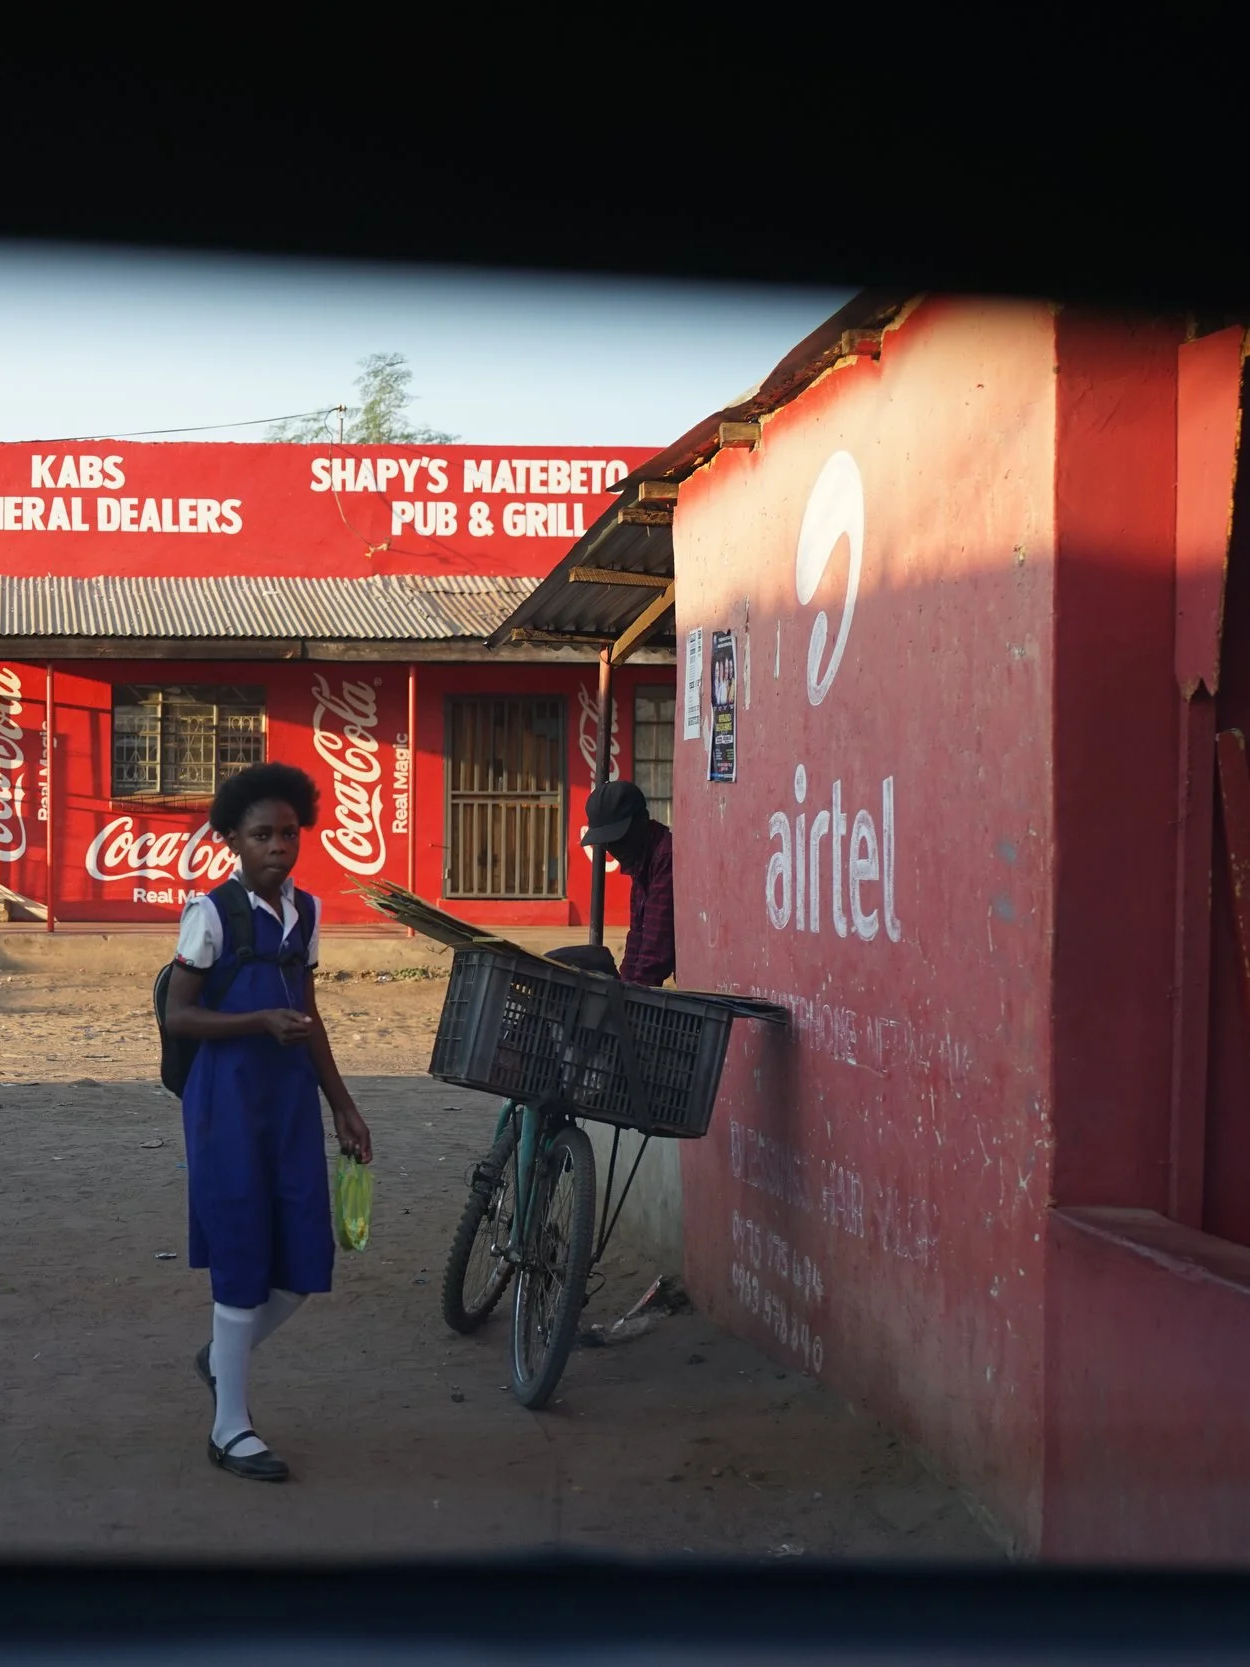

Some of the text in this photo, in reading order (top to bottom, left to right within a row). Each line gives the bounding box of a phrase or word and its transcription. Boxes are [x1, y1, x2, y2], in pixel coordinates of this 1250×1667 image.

[31, 455, 126, 489] KABS
[310, 457, 629, 494] SHAPY'S MATEBETO
[97, 498, 243, 535] DEALERS
[391, 502, 589, 537] PUB & GRILL
[311, 673, 386, 875] Coca-Cola
[392, 733, 410, 834] Real Magic
[85, 816, 243, 881] Coca-Co
[766, 763, 901, 942] airtel
[133, 888, 174, 904] Real
